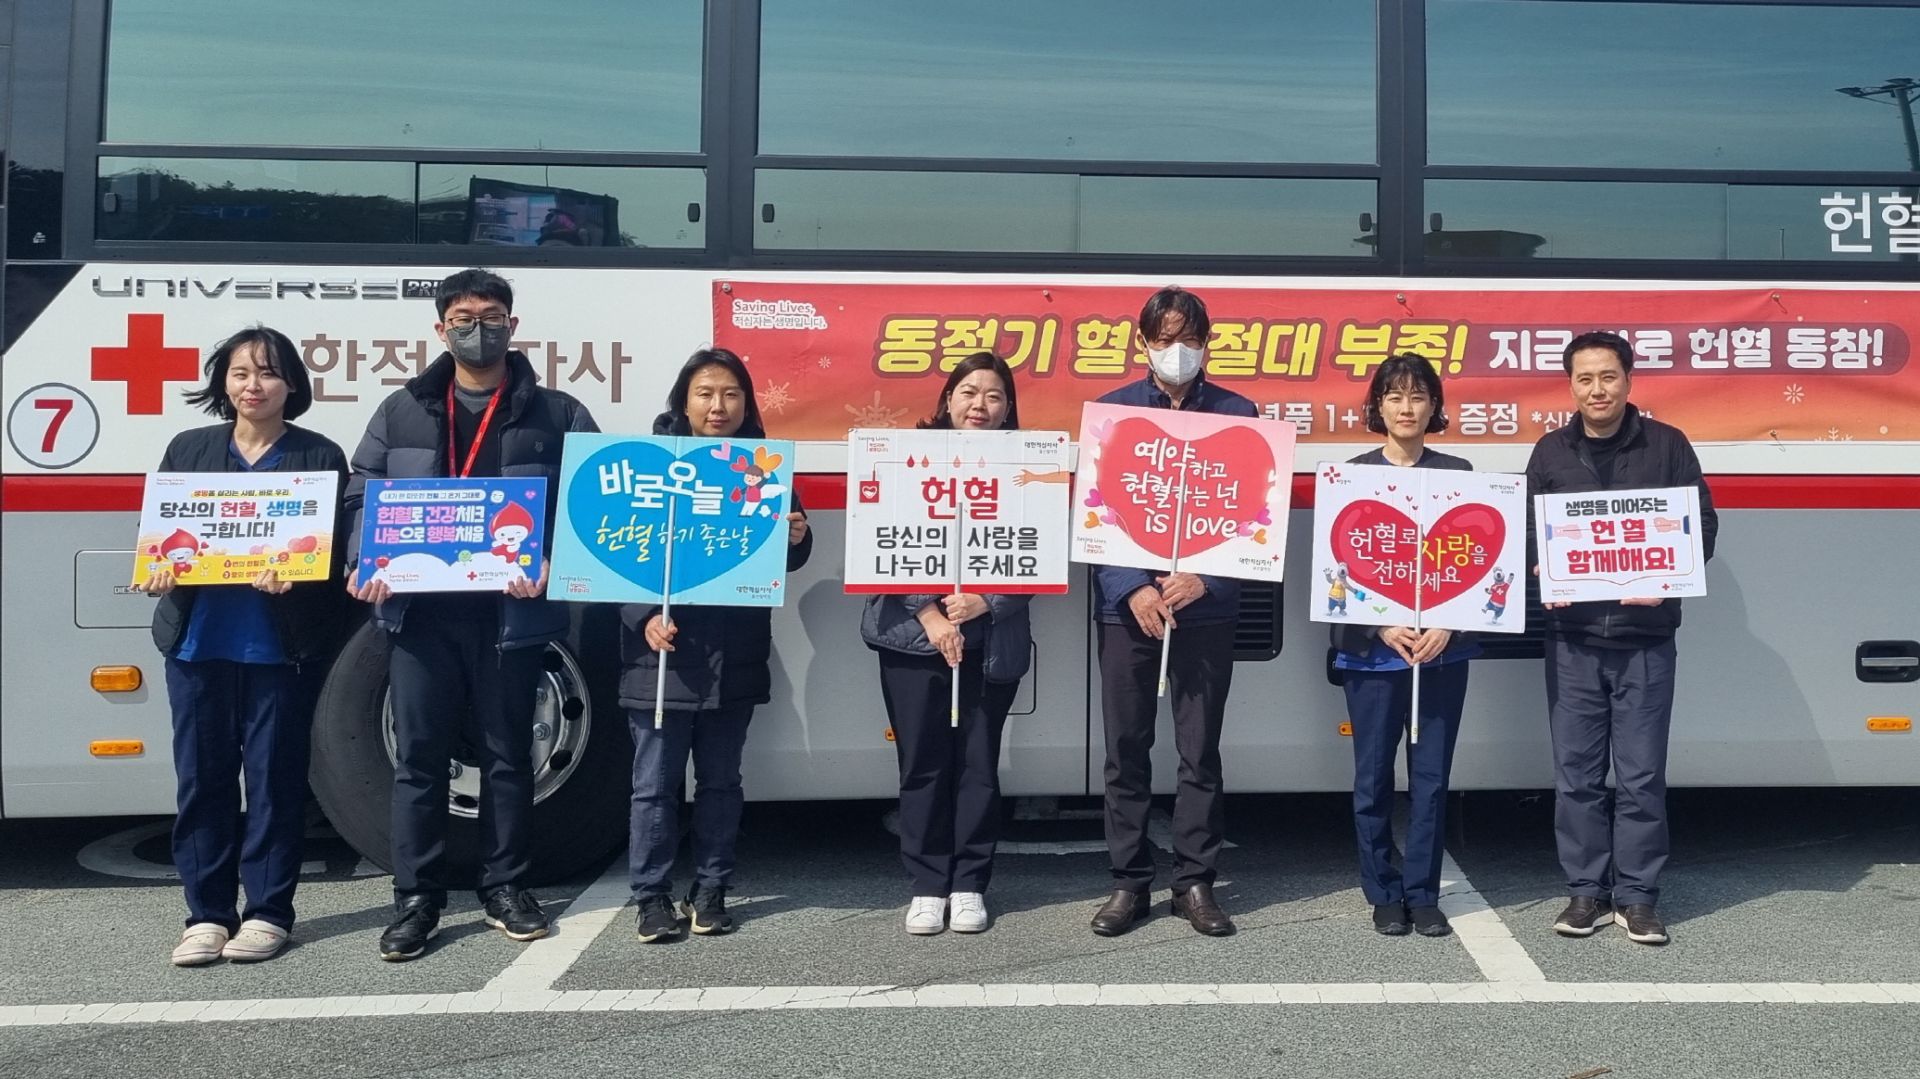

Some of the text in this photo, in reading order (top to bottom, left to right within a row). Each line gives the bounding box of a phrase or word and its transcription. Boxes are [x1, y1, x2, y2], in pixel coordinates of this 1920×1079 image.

[92, 275, 441, 299] UNIVERSE PRI
[734, 301, 815, 314] Saving Lives,
[878, 319, 1057, 373] 동절기
[1073, 320, 1151, 374] 혈
[1206, 322, 1321, 376] 절대
[1623, 330, 1673, 369] 로
[1688, 327, 1772, 370] 헌혈
[1786, 328, 1884, 370] 동참!
[34, 399, 73, 453] 7
[1459, 403, 1518, 436] 증정
[921, 476, 999, 520] 헌혈
[1216, 480, 1239, 509] 넌
[1566, 497, 1668, 517] 생명을 이어주는
[160, 500, 319, 519] 당신의 헌혈, 생명을
[377, 505, 485, 525] 헌혈로 건강체크
[200, 522, 276, 539] 구합니다!
[374, 525, 484, 544] 나눔으로 행복채움
[1144, 507, 1240, 540] is love
[876, 525, 1039, 551] 당신의 사랑을
[1347, 522, 1418, 560] 헌혈로
[875, 554, 1039, 577] 나누어 주세요
[1566, 546, 1676, 574] 함께해요!
